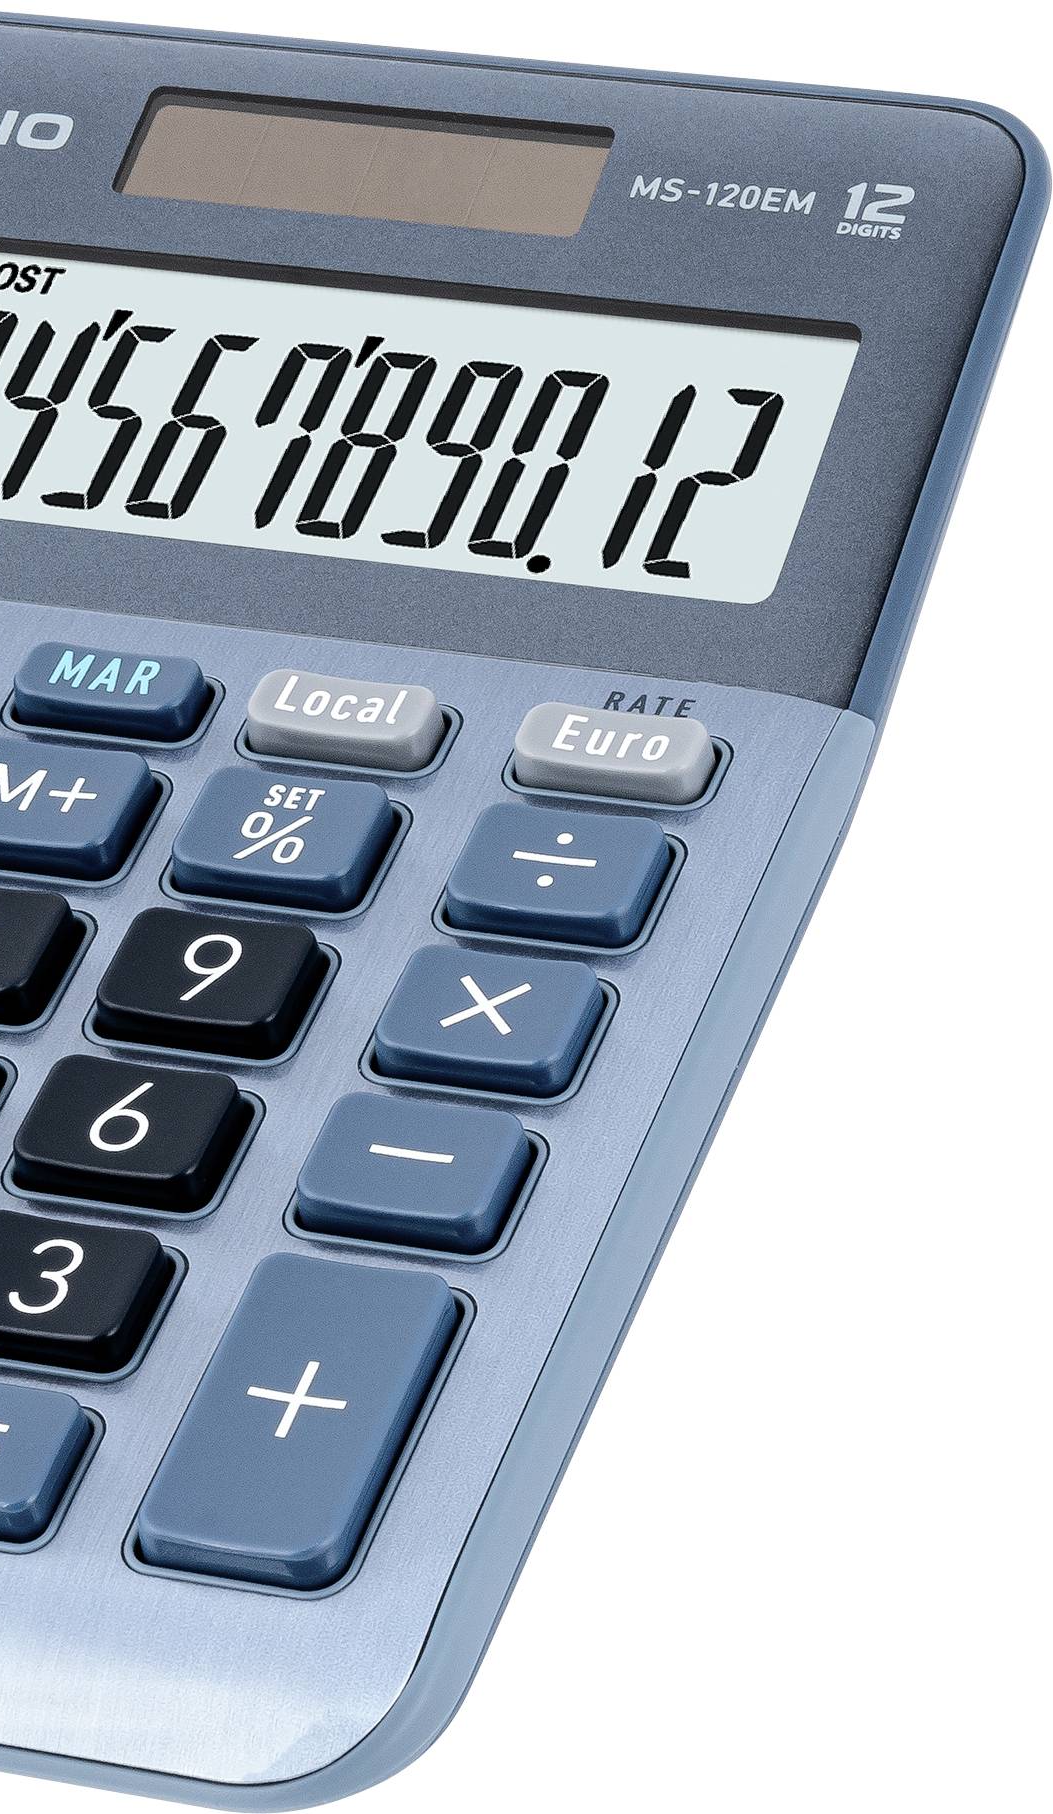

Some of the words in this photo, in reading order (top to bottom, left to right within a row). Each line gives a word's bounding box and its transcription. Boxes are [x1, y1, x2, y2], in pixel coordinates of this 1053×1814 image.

[630, 176, 816, 214] MS-120EM
[843, 182, 915, 224] 12
[836, 221, 903, 240] DIGITS
[49, 651, 160, 694] MAR
[275, 676, 407, 724] Local
[603, 691, 696, 717] RATE
[552, 715, 669, 760] Euro
[264, 785, 325, 810] SET
[233, 811, 313, 864] %
[180, 935, 241, 1000] 9
[90, 1083, 153, 1151] 6
[9, 1240, 83, 1313] 3
